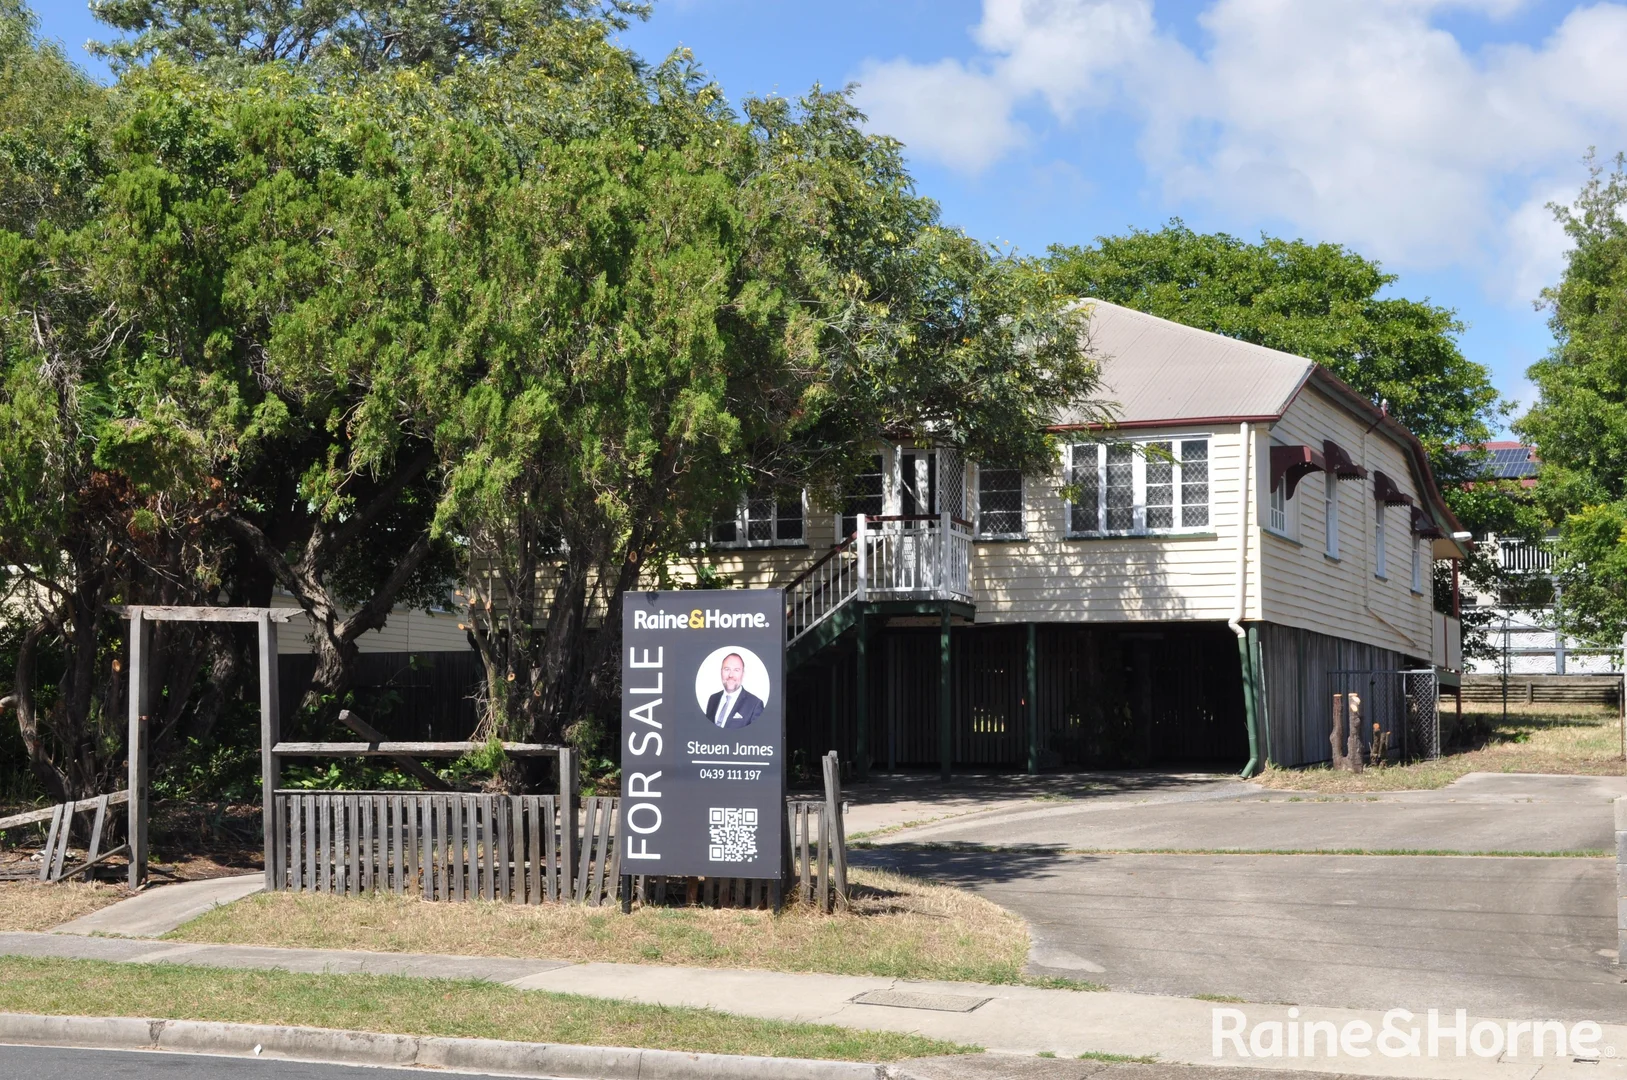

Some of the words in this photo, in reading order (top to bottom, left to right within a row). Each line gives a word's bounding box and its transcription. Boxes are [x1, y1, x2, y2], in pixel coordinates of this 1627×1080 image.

[634, 609, 770, 629] Raine&Horne.
[628, 646, 664, 757] SALE
[687, 741, 730, 755] Steven
[733, 743, 774, 757] James
[700, 769, 725, 780] 0439
[727, 770, 742, 780] 111
[744, 770, 761, 780] 197
[627, 771, 663, 860] FOR
